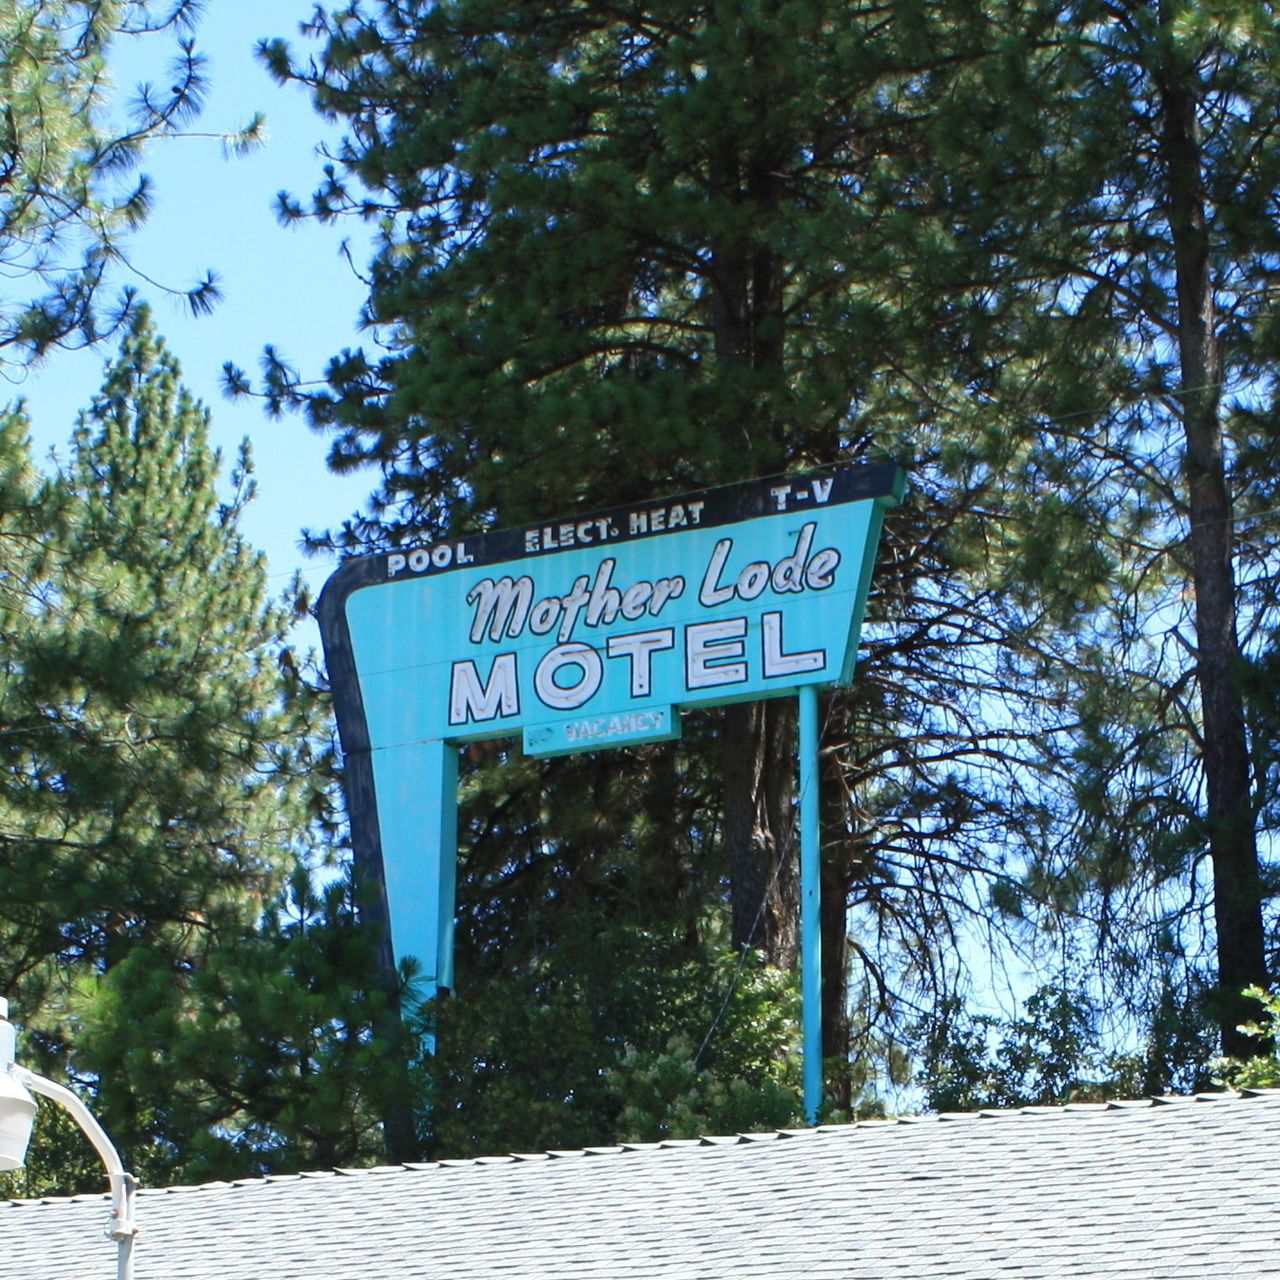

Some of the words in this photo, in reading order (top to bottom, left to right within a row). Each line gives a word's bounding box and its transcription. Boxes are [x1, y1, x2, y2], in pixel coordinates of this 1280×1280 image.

[387, 543, 474, 577] POOL
[525, 517, 620, 552] ELECT.
[629, 501, 705, 535] HEAT
[770, 478, 834, 511] T-V
[467, 558, 686, 644] Mother
[698, 522, 841, 607] Lode
[448, 612, 827, 725] MOTEL
[565, 711, 664, 742] VACANCY
